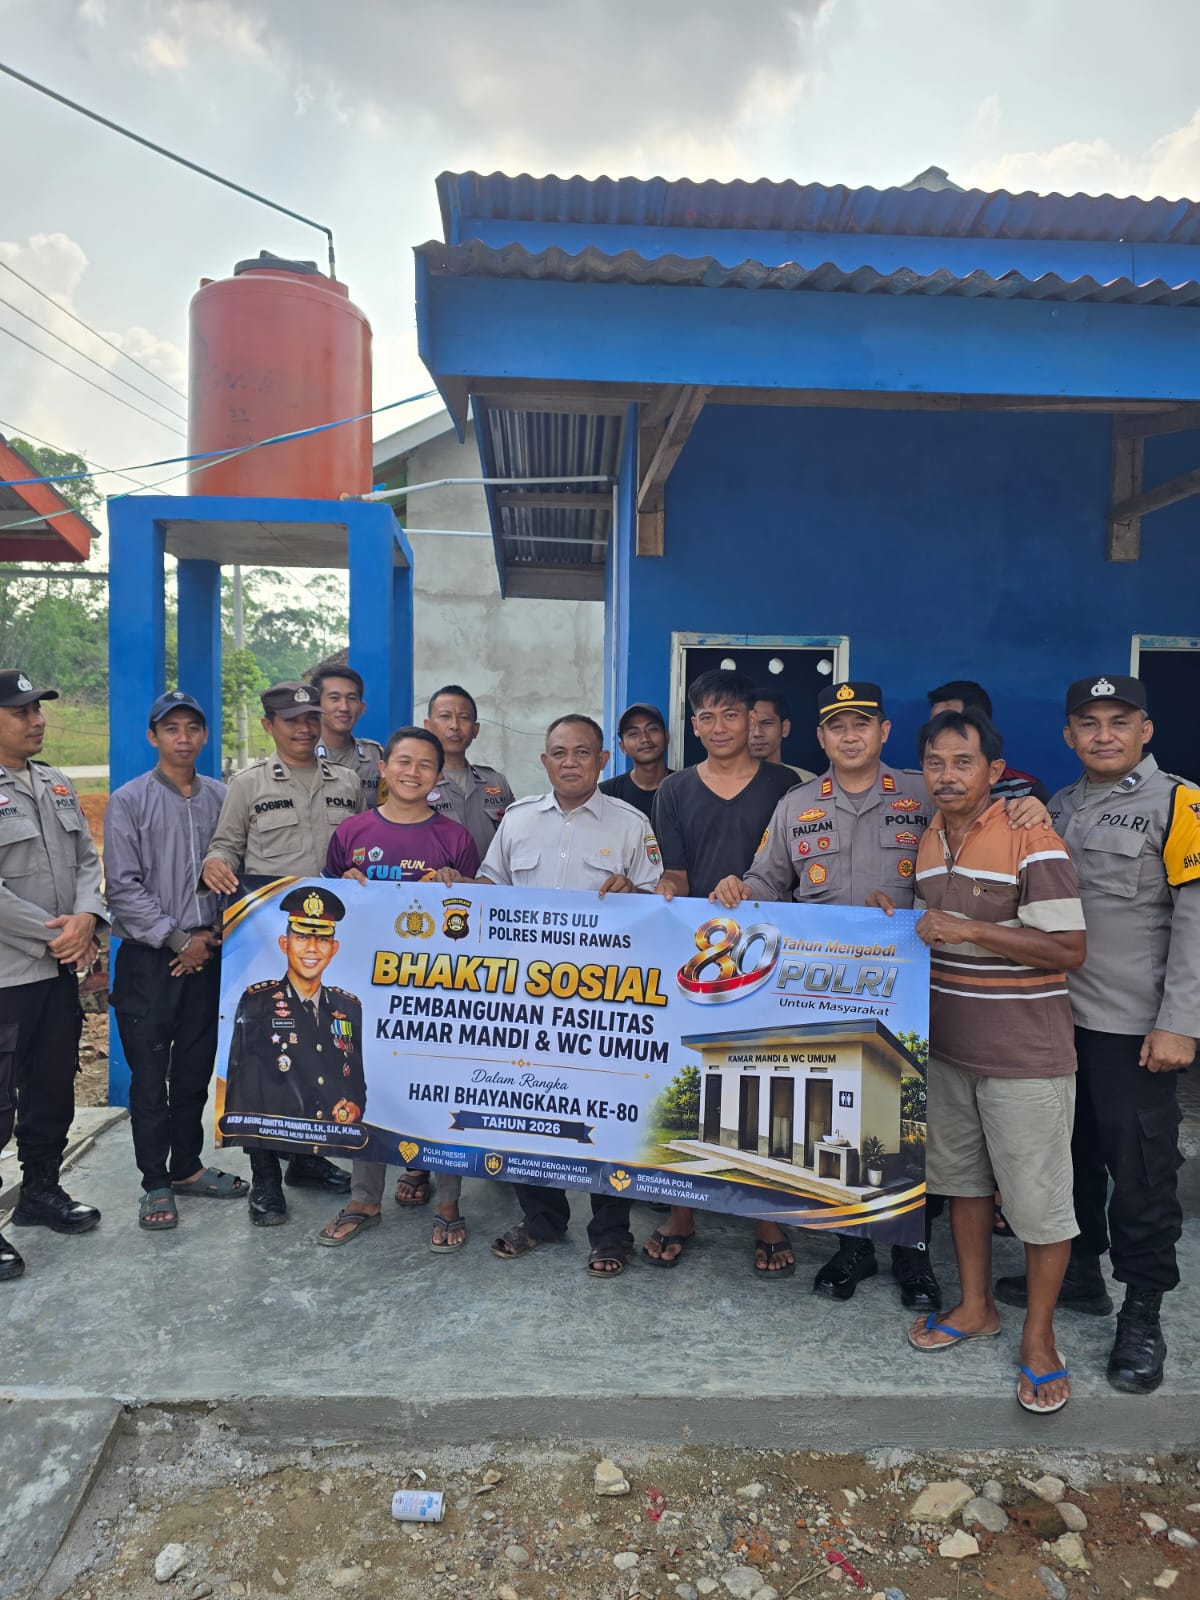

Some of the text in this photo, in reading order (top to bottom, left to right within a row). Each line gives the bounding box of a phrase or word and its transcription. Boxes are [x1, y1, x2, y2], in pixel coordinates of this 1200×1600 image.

[56, 799, 75, 807] POLR
[326, 797, 356, 809] POLRI
[793, 821, 833, 838] FAUZAN
[885, 815, 928, 826] POLRI
[1098, 814, 1150, 833] POLRI
[401, 859, 425, 869] RUN
[489, 908, 599, 928] POLSEK BTS ULU
[488, 926, 631, 949] POLRES MUSI RAWAS
[679, 917, 781, 990] 80
[783, 937, 897, 958] Tahun Mengabdi
[372, 951, 668, 1007] BHAKTI SOSIAL
[776, 959, 899, 998] POLRI
[388, 995, 654, 1035] PEMBANGUNAN FASILITAS
[779, 998, 890, 1017] Untuk Masyarakat
[376, 1018, 669, 1064] KAMAR MANDI & WC UMUM
[728, 1054, 836, 1064] KAMAR MANDI & WC UMUM
[471, 1068, 569, 1093] Dalam Rangka
[409, 1083, 639, 1123] HARI BHAYANGKARA KE-80
[259, 1128, 327, 1141] KAPOLRES MUSI RAWAS
[481, 1116, 561, 1135] TAHUN 2026
[423, 1147, 466, 1159] POLRI PRESISI
[423, 1156, 469, 1169] UNTUK NEGERI
[508, 1157, 588, 1174] MELAYANI DENGAN HATI
[507, 1166, 592, 1185] MENGABDI UNTUK NEGERI
[637, 1174, 693, 1189] BERSAMA POLRI
[636, 1184, 709, 1202] UNTUK MASYARAKAT
